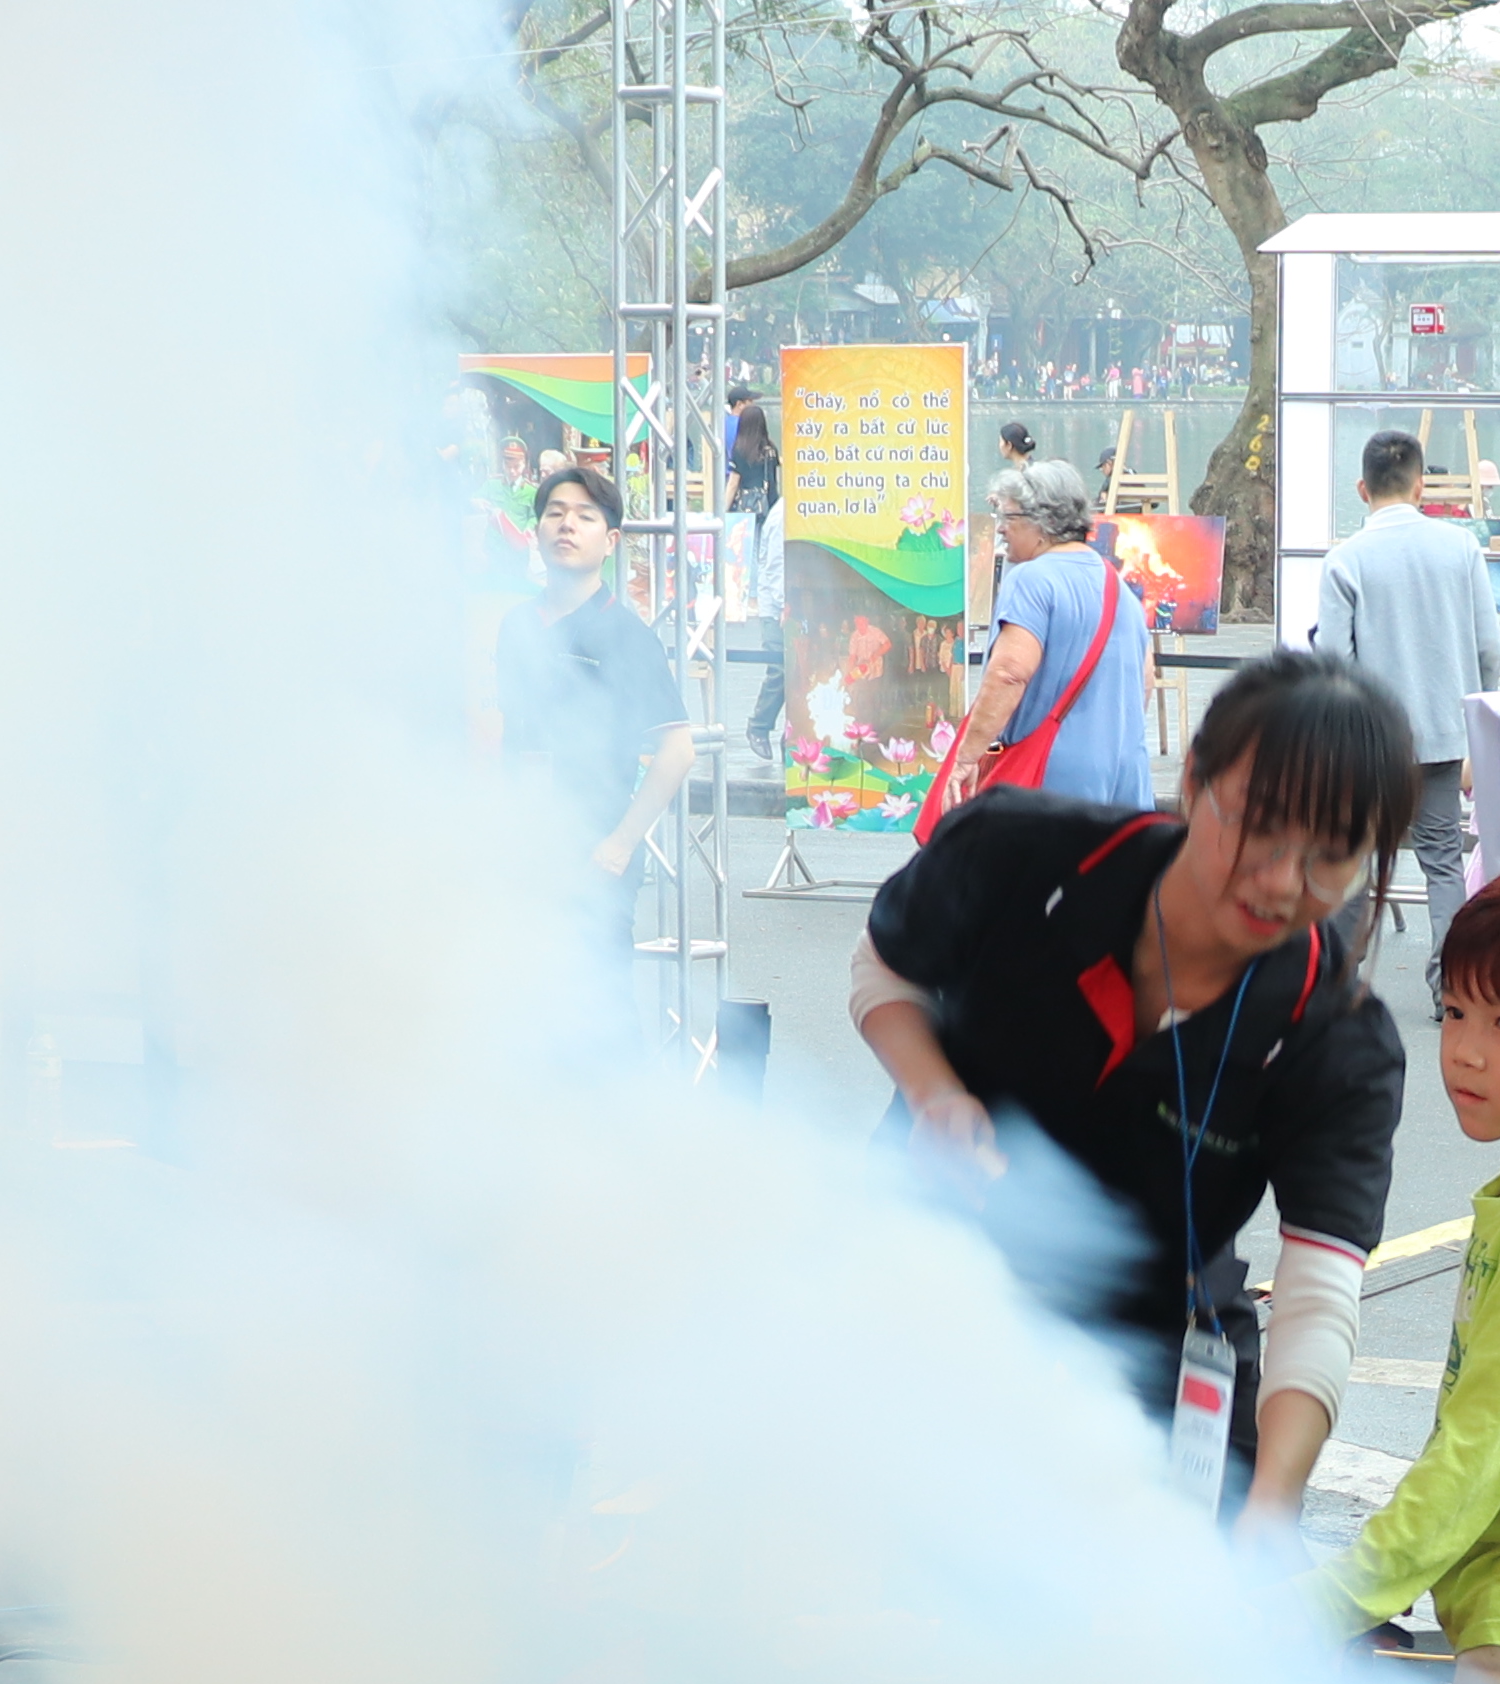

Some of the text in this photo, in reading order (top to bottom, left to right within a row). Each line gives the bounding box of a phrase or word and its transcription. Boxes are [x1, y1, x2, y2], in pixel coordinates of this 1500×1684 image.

[859, 389, 880, 408] nổ
[892, 393, 910, 408] có
[923, 389, 950, 408] thể
[796, 418, 949, 439] xảy ra bất cứ lúc
[797, 444, 949, 463] nào, bất cứ nơi đâu
[797, 470, 949, 491] nếu chúng ta chủ
[797, 501, 841, 517] quan,
[845, 498, 860, 514] lơ
